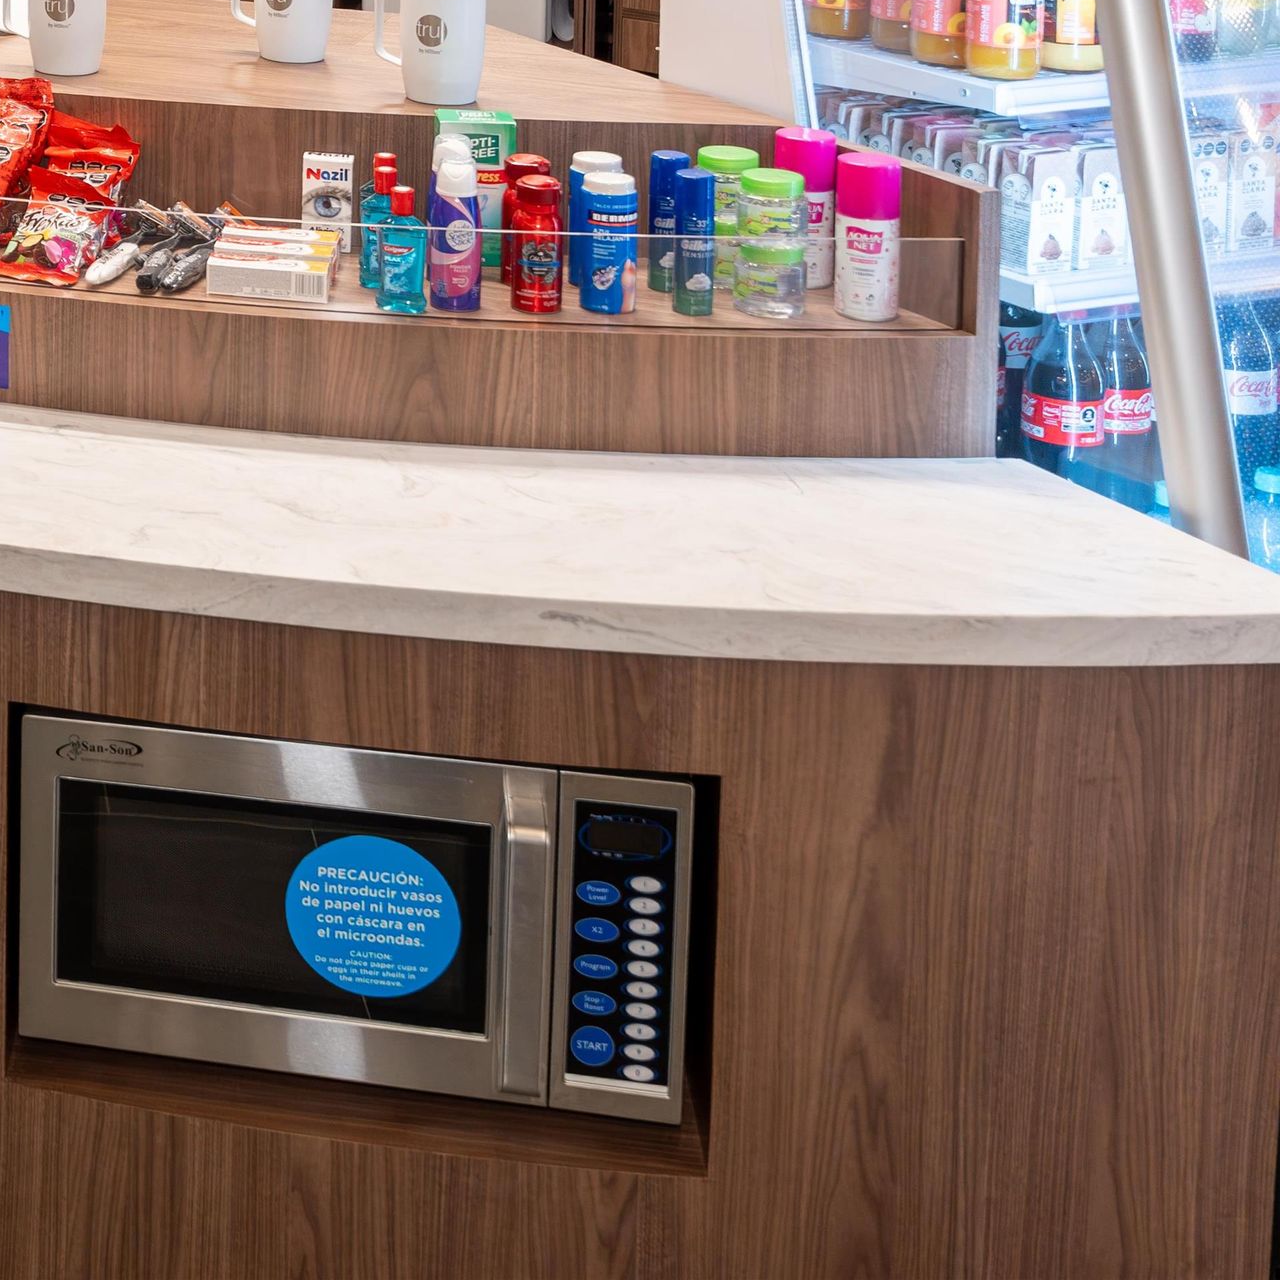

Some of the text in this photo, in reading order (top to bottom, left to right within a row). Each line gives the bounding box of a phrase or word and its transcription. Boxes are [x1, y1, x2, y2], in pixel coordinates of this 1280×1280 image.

[417, 21, 440, 39] tru
[471, 136, 496, 149] PTI-
[471, 147, 497, 159] REE
[306, 167, 349, 182] Nazil
[847, 231, 884, 244] AQUA
[384, 245, 410, 254] Colgate
[852, 241, 876, 251] NET
[384, 255, 402, 263] PLAX
[1003, 331, 1044, 353] Coca
[80, 740, 133, 756] San-Son
[317, 866, 425, 887] PRECAUCIÓN:
[299, 880, 443, 904] No introducir vasos
[586, 883, 609, 894] Power
[587, 892, 607, 901] Level
[301, 895, 441, 919] de papel ni huevos
[316, 913, 426, 932] con cáscara en
[591, 925, 603, 934] X2
[316, 927, 425, 948] el microondas.
[349, 950, 393, 961] CAUTION:
[314, 954, 327, 963] Do
[328, 955, 343, 965] not
[345, 957, 368, 968] place
[370, 960, 395, 971] paper
[397, 963, 417, 973] cups
[580, 960, 611, 971] Program
[327, 966, 348, 975] eggs
[350, 966, 358, 974] in
[360, 967, 379, 976] their
[381, 970, 406, 980] shells
[339, 974, 404, 988] the microwave.
[583, 994, 600, 1003] Stop
[583, 1002, 605, 1011] Reset
[576, 1039, 609, 1052] START
